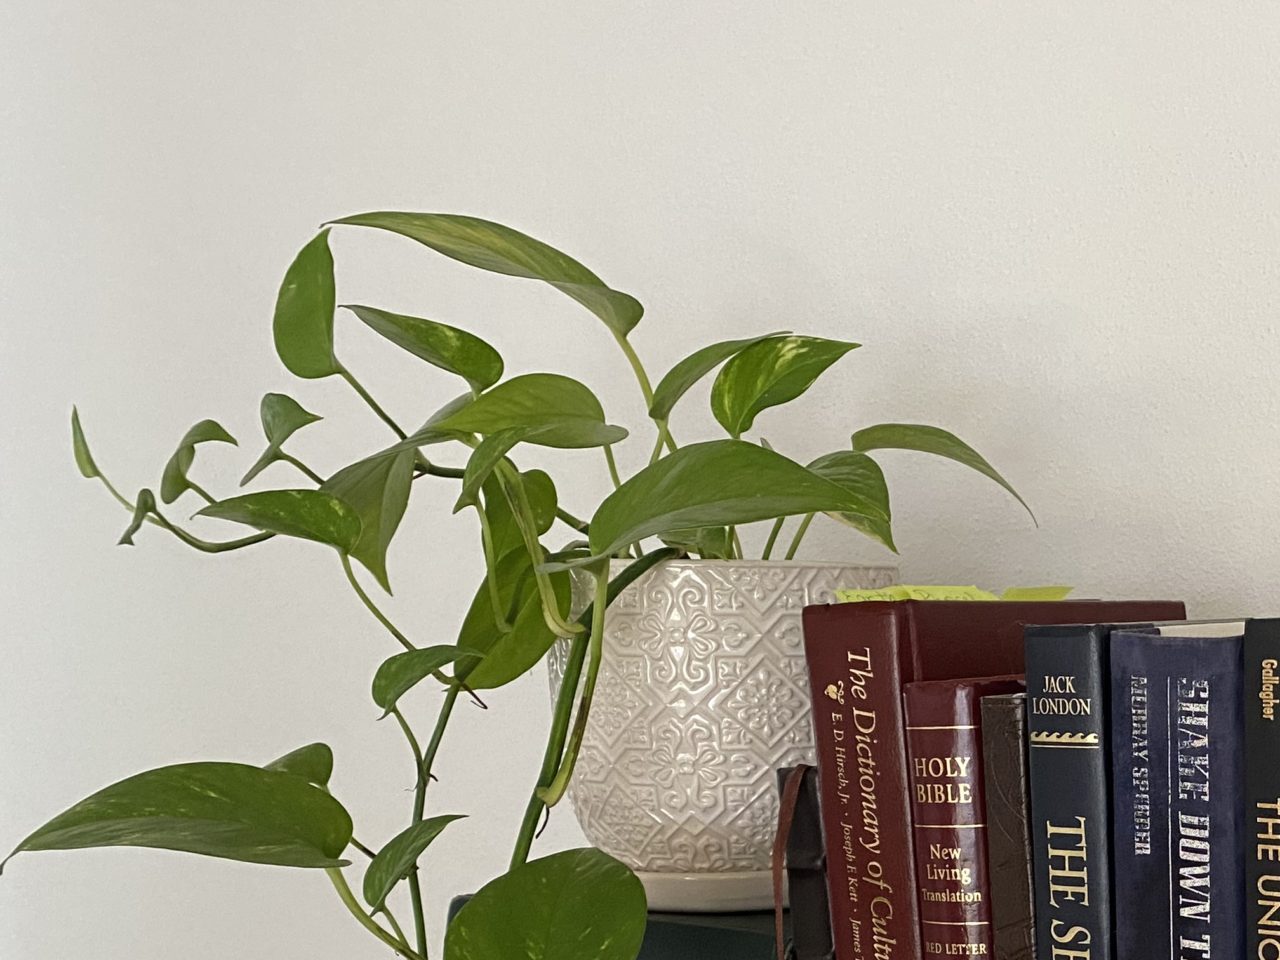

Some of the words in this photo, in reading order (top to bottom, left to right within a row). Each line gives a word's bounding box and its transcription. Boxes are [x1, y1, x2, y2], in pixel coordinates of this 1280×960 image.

[847, 647, 874, 700] The
[1043, 675, 1076, 693] JACK
[1259, 658, 1280, 721] Gallagher
[1032, 698, 1091, 716] LONDON
[831, 712, 843, 725] E.
[834, 729, 845, 743] D.
[1178, 677, 1210, 802] SHAKE
[914, 757, 971, 778] HOLY
[852, 707, 881, 853] Dictionary
[838, 791, 851, 805] Jr.
[917, 784, 972, 804] BIBLE
[841, 822, 856, 862] Joseph
[930, 844, 962, 861] New
[1046, 815, 1090, 908] THE
[1178, 811, 1210, 923] DOWN
[863, 861, 892, 894] of
[927, 864, 971, 883] Living
[848, 876, 860, 902] Kett
[922, 888, 982, 902] Translation
[850, 917, 863, 953] James
[926, 942, 942, 954] RED
[945, 943, 988, 955] LETTER
